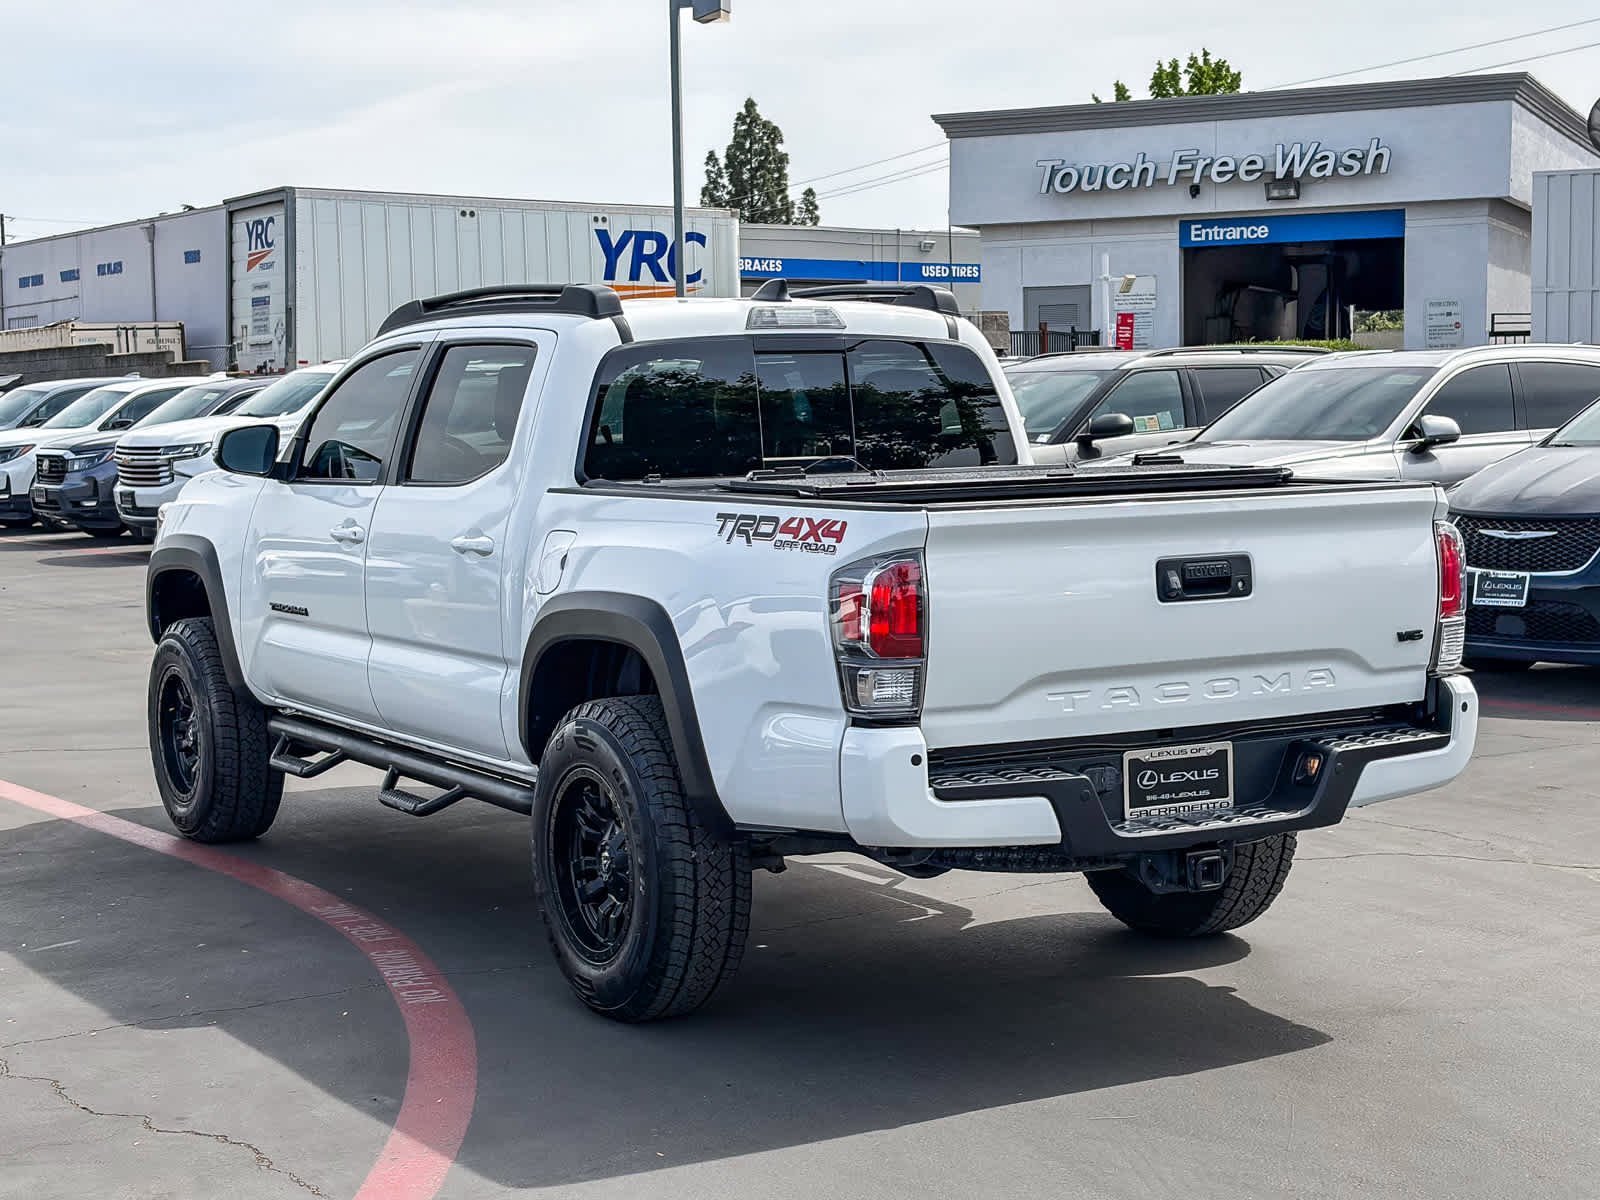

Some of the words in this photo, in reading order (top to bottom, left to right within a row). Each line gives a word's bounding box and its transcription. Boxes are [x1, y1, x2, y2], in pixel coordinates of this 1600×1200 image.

[1035, 152, 1158, 195] Touch
[1167, 148, 1265, 186] Free
[1272, 137, 1393, 181] Wash
[245, 216, 275, 252] YRC
[1190, 223, 1270, 243] Entrance
[594, 229, 707, 284] YRC
[738, 258, 783, 272] BRAKES
[921, 264, 949, 278] USED
[951, 265, 980, 279] TIRES
[716, 513, 781, 547] TRD
[778, 516, 848, 544] 4X4
[773, 539, 800, 552] OFF
[800, 541, 838, 555] ROAD
[1187, 564, 1231, 578] TOYOTA
[1046, 665, 1337, 713] TACOMA
[1150, 748, 1188, 759] LEXUS
[1190, 746, 1206, 755] OF
[1160, 768, 1219, 783] LEXUS
[1129, 801, 1230, 819] SACRAMENTO
